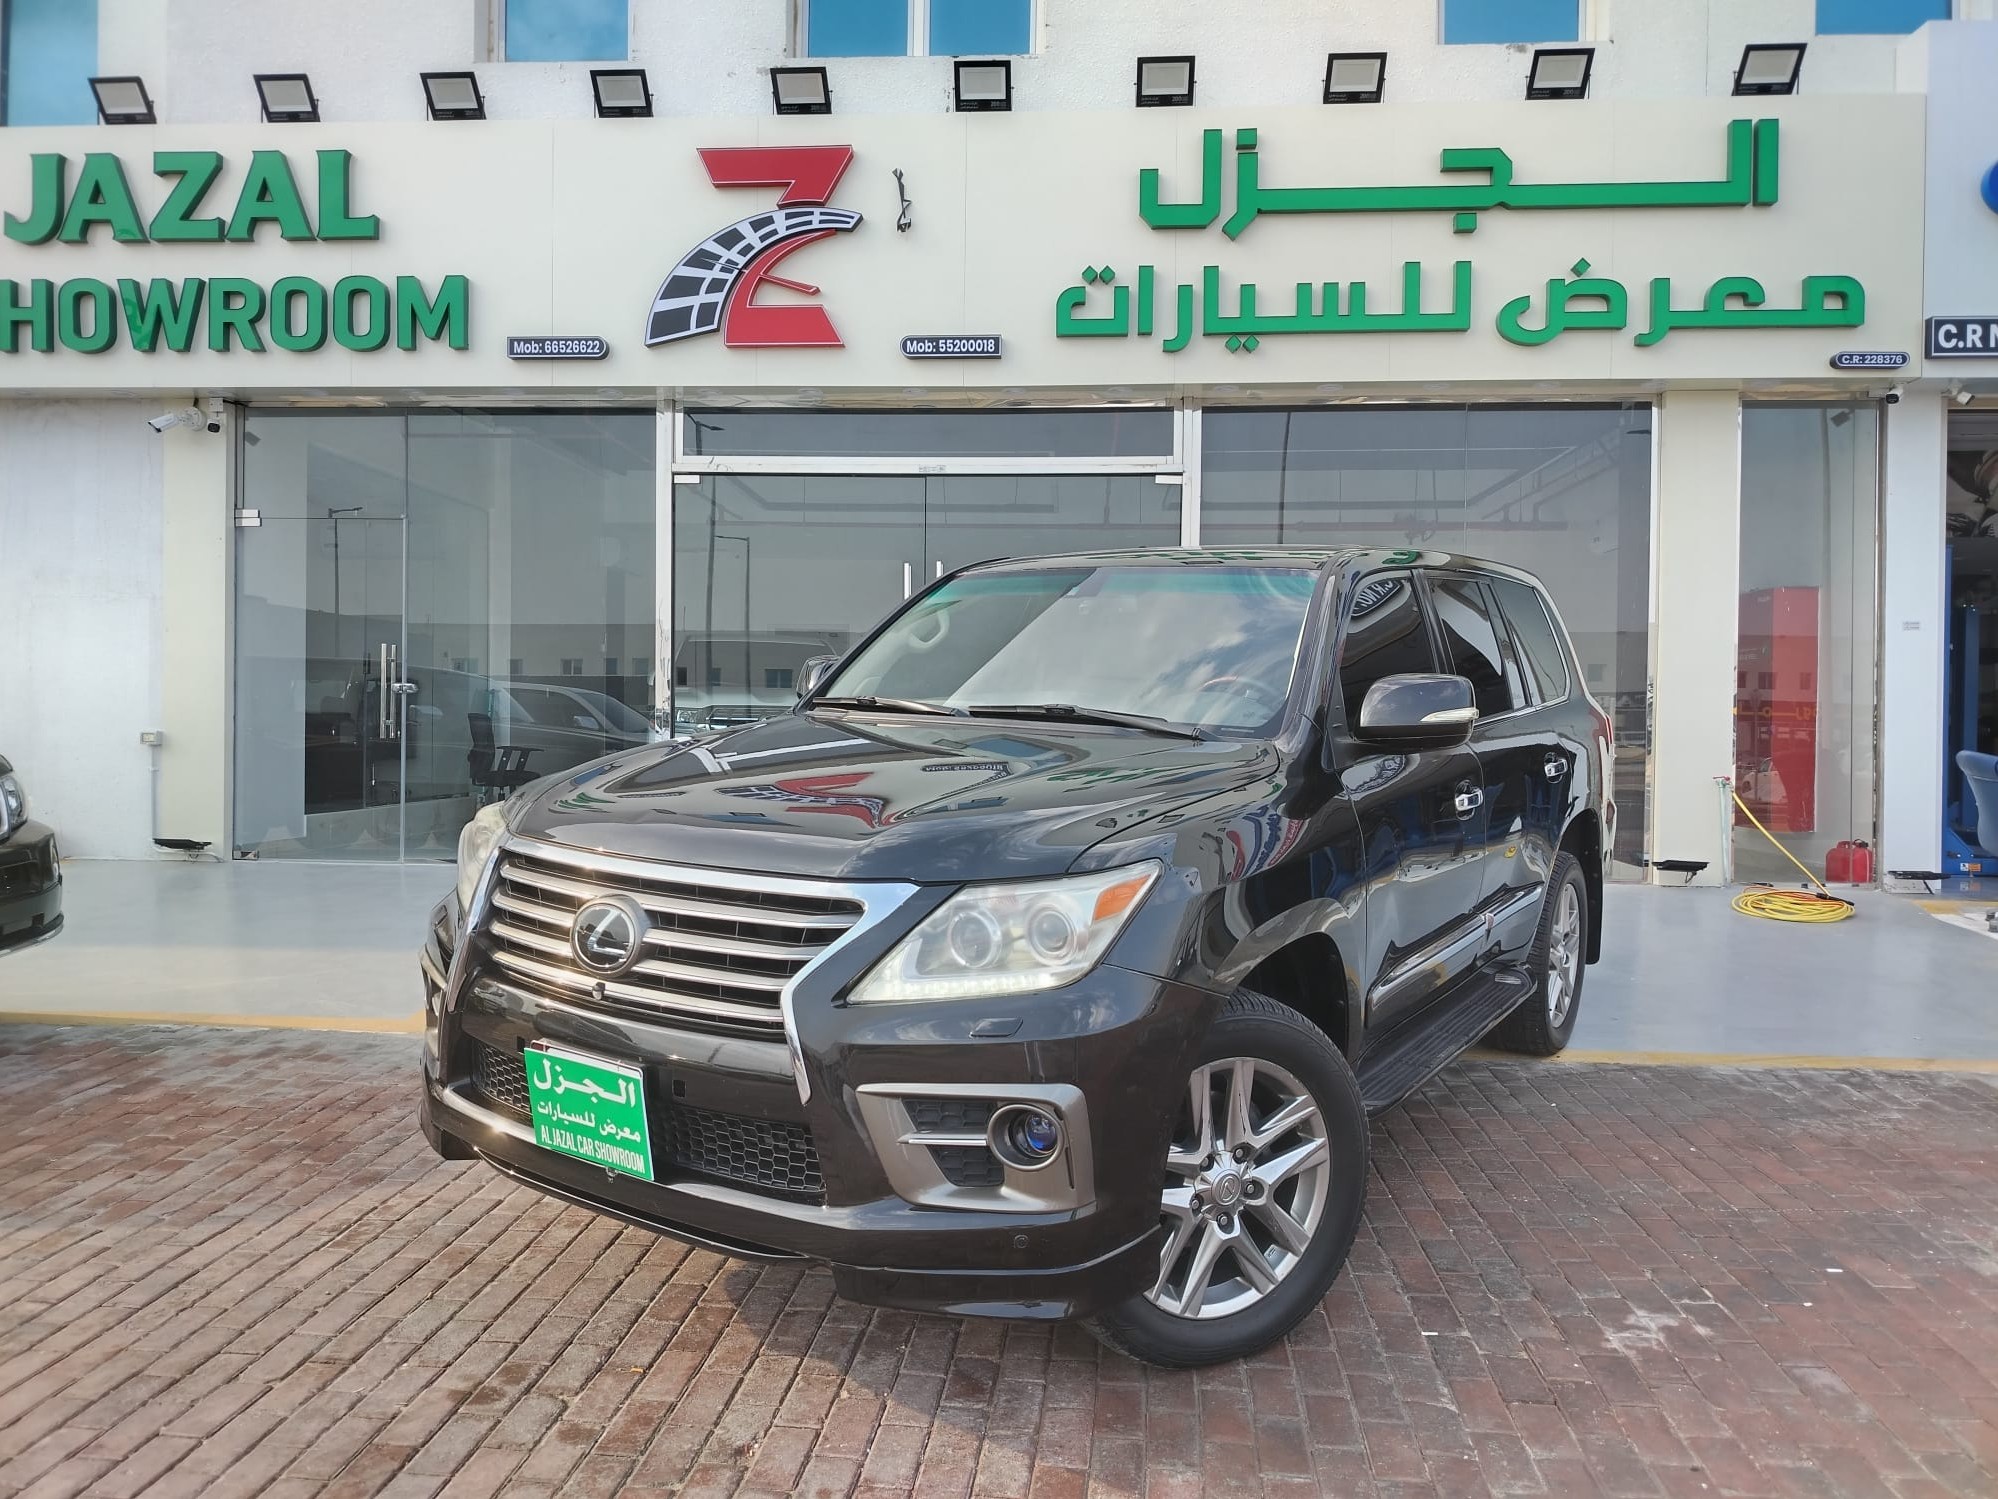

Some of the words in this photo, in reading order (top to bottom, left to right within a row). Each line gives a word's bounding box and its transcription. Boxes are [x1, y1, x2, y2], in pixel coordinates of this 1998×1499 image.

[4, 149, 380, 245] JAZAL
[1056, 260, 1473, 354] للسيارات
[1496, 257, 1866, 347] معرض
[513, 340, 543, 354] Mob:
[544, 340, 600, 353] 66526622
[906, 339, 936, 353] Mob:
[938, 339, 995, 352] 55200018
[1938, 323, 1983, 349] C.R
[1841, 355, 1863, 364] C.R:
[1864, 355, 1903, 364] 228376
[533, 1058, 637, 1109] الجزل
[537, 1101, 596, 1128] للسيارات
[599, 1118, 642, 1143] معرض
[541, 1125, 552, 1145] AL
[552, 1127, 578, 1152] JAZAL
[577, 1135, 596, 1157] CAR
[595, 1140, 646, 1175] SHOWROOM
